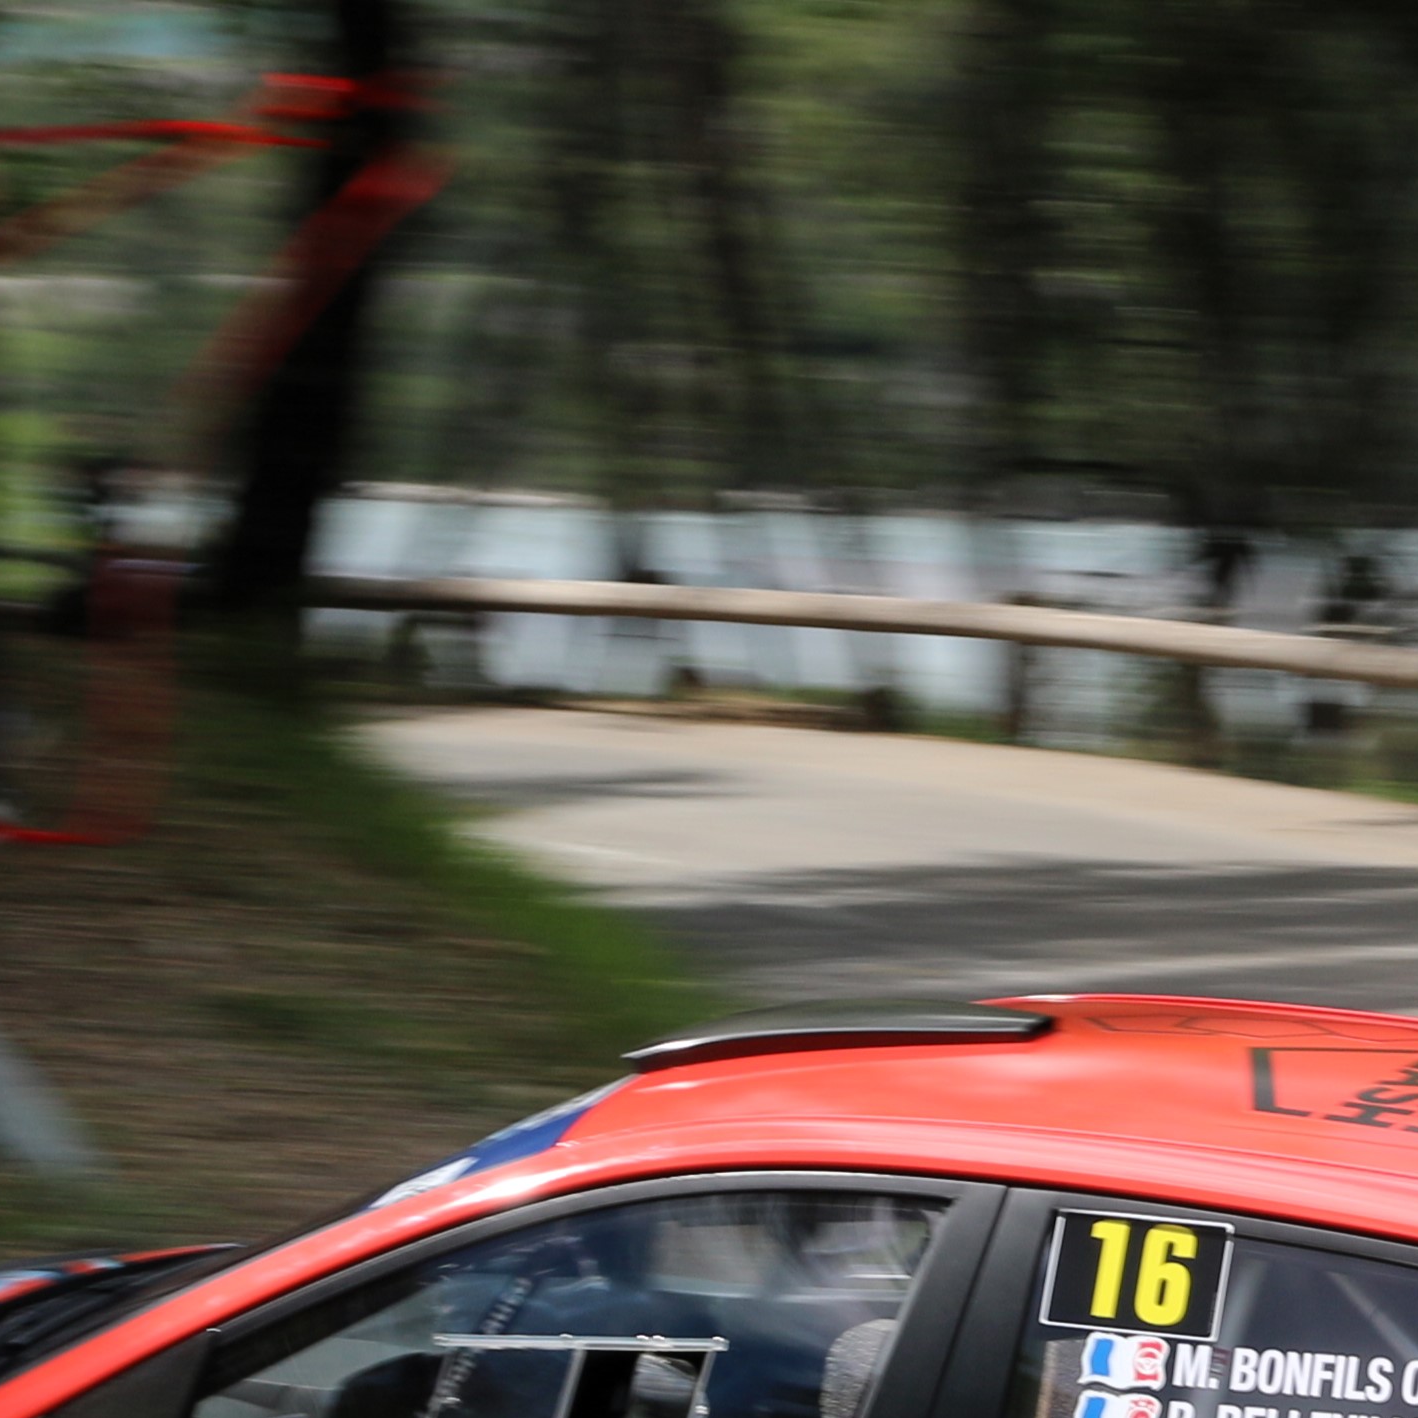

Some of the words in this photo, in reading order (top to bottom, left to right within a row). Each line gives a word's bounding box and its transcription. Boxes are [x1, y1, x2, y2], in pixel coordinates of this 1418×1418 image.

[1090, 1219, 1198, 1326] 16
[1172, 1344, 1220, 1391] M.
[1229, 1348, 1393, 1403] BONFILS
